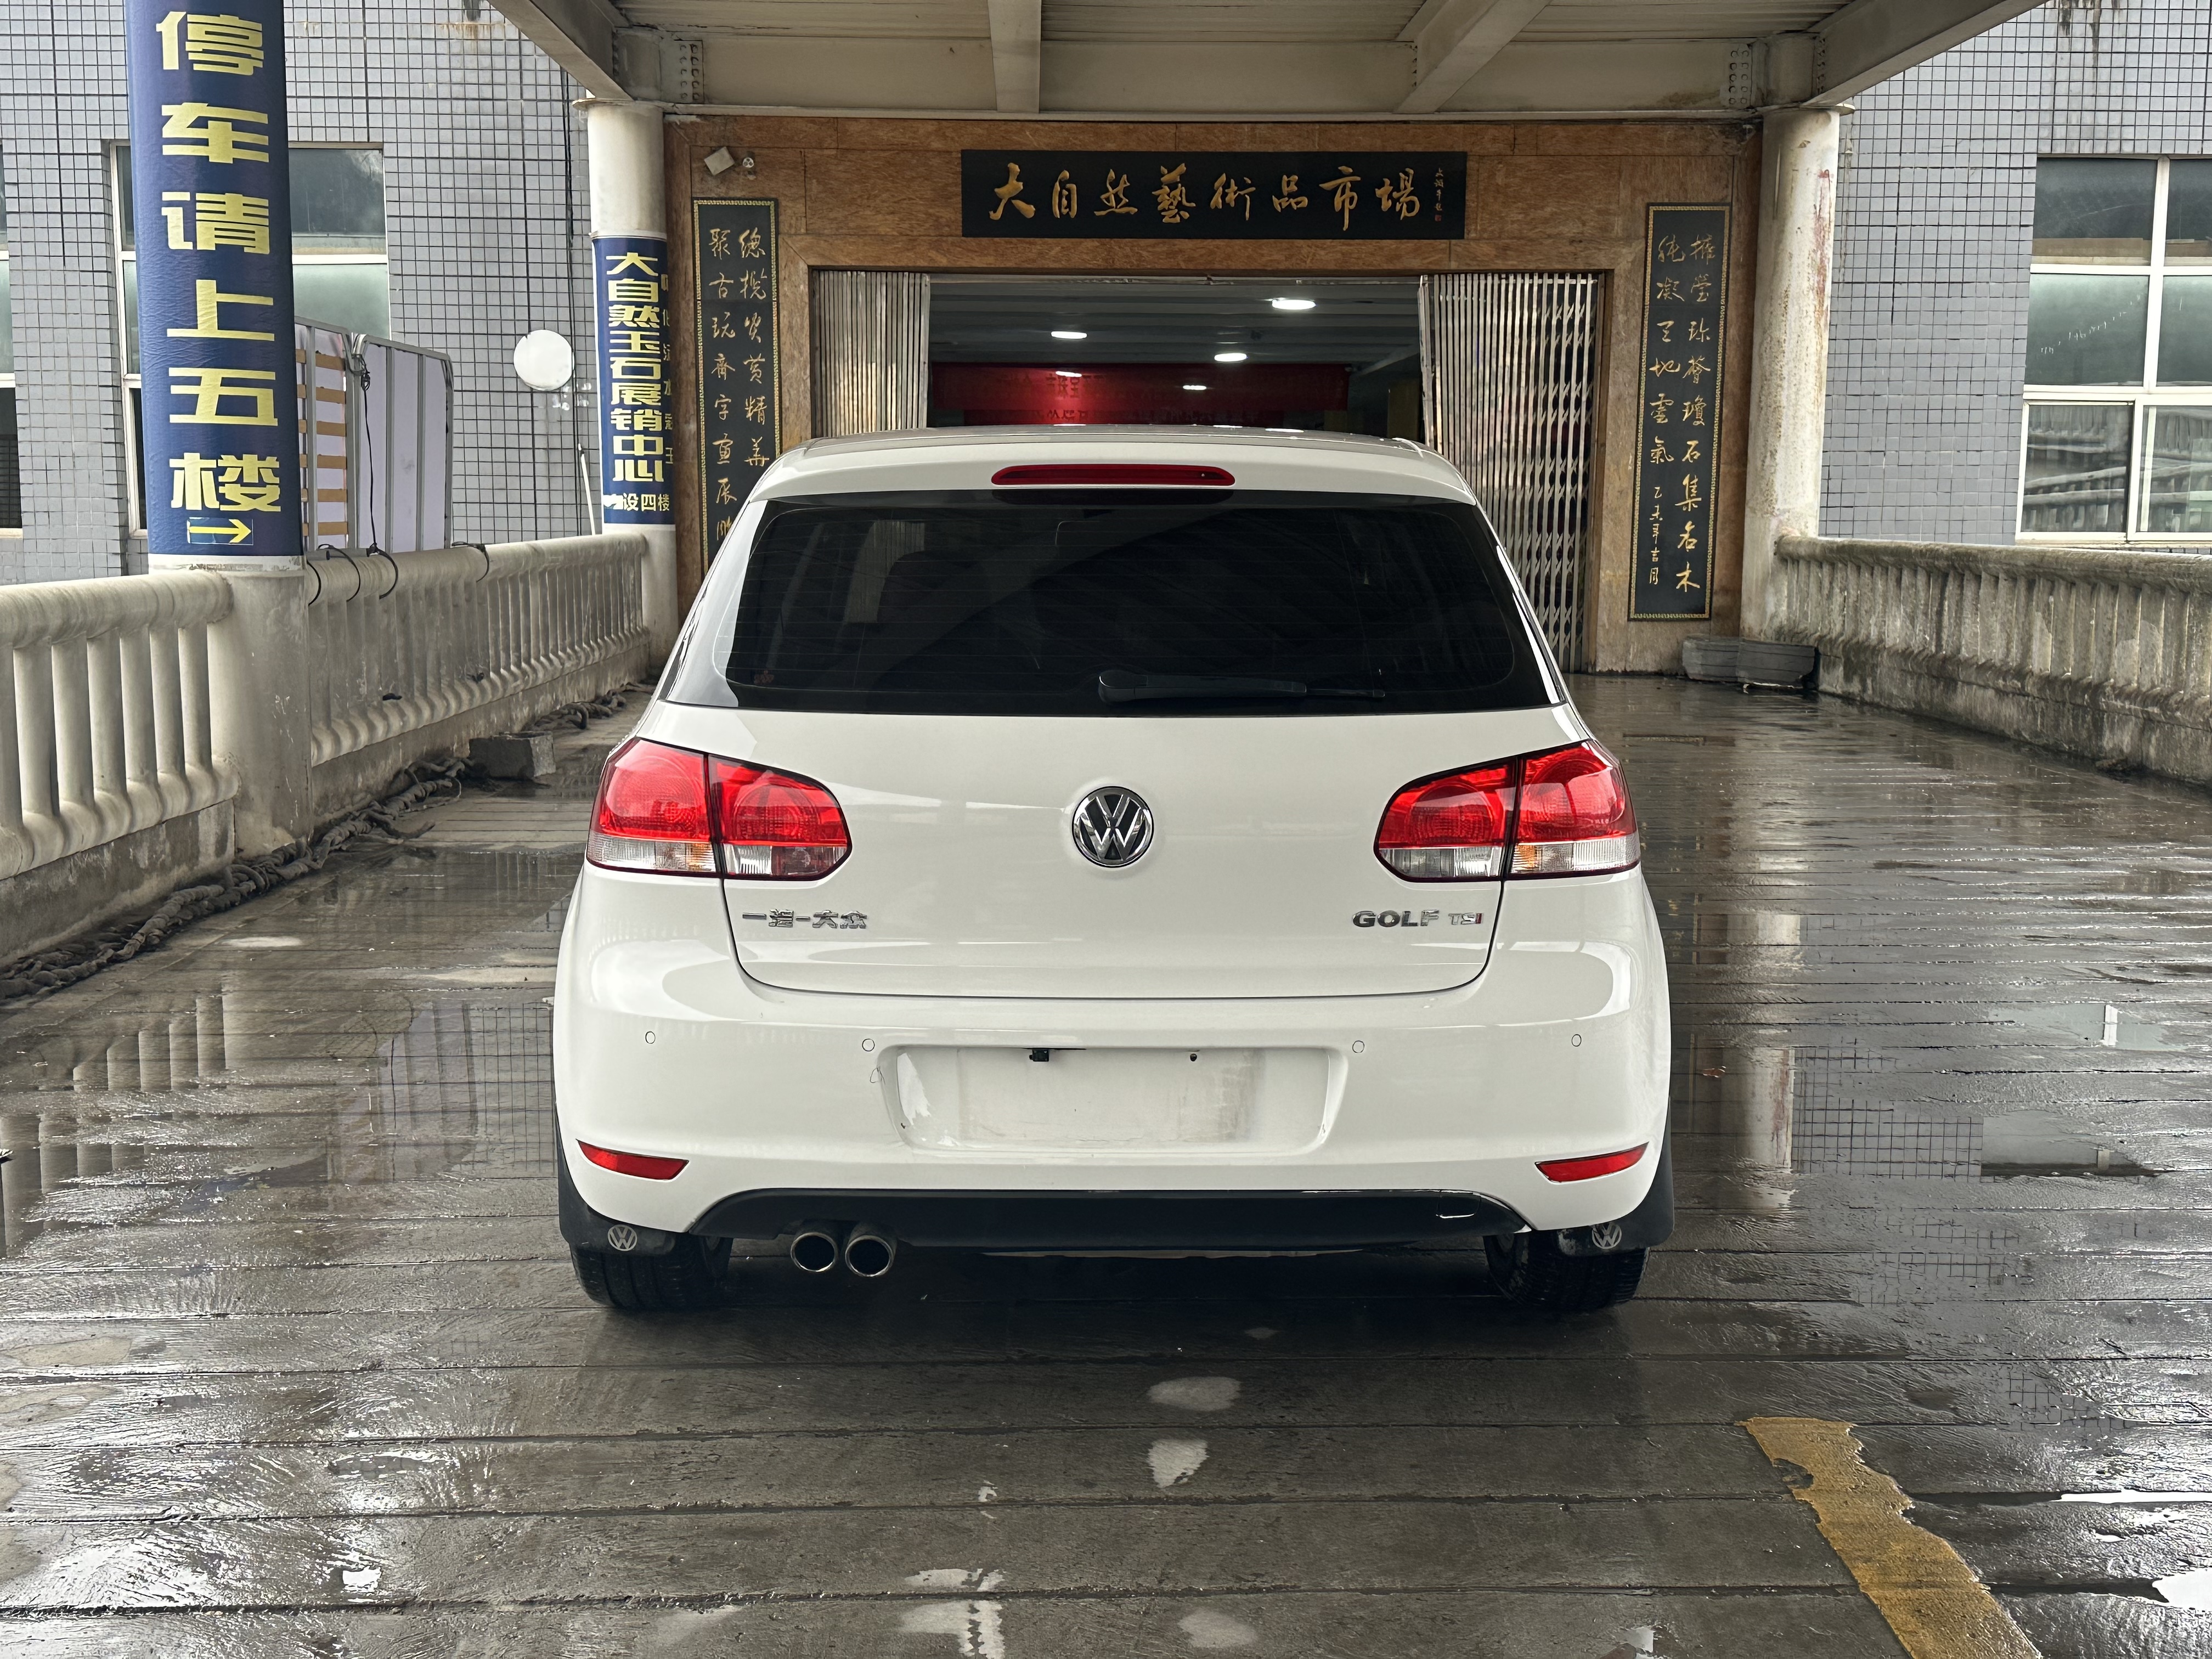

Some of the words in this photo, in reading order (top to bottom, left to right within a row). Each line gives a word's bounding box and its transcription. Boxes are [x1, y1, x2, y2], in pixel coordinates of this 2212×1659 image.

[156, 10, 282, 513] 停车请上五楼
[605, 251, 665, 482] 大自然玉石展销中心
[1352, 909, 1440, 928] GOLF
[1448, 912, 1484, 926] TSI
